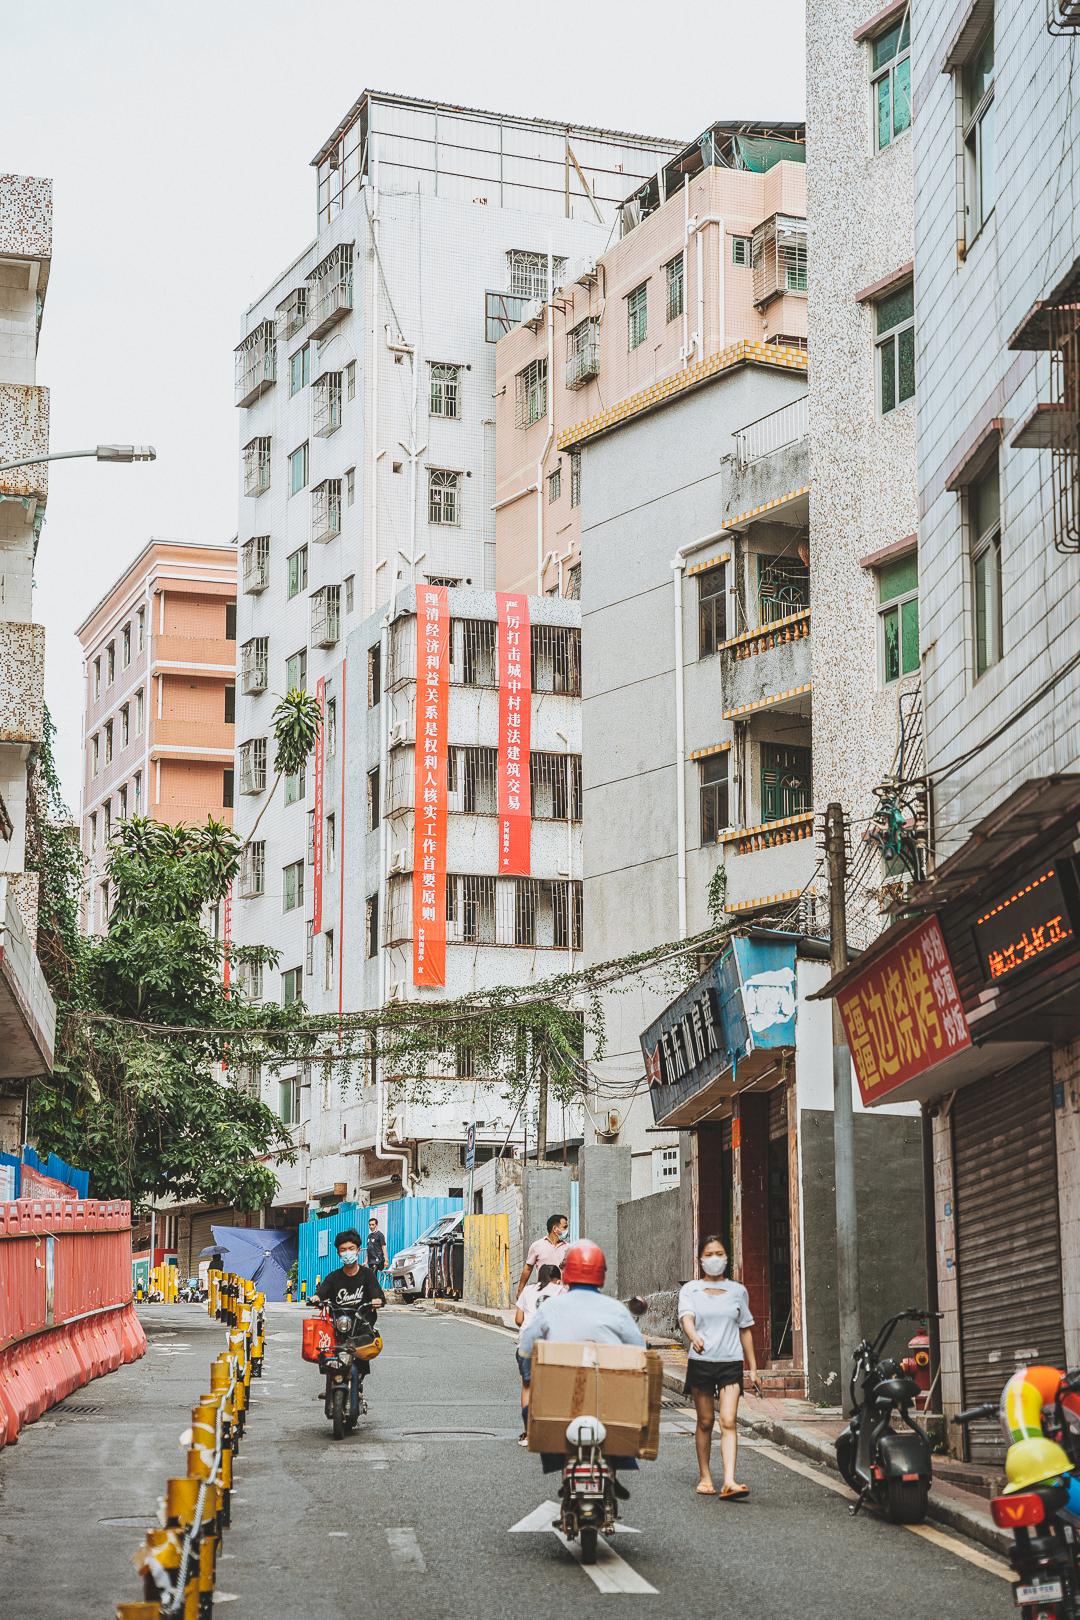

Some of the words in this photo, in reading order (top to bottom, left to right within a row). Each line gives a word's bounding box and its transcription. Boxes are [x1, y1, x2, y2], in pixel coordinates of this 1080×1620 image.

[505, 600, 523, 810] 严厉打击城中村违法建筑交易
[422, 592, 440, 922] 理清经济利益关系是权利人核实工作首要原则
[920, 925, 946, 969] 炒粉
[932, 965, 957, 1009] 炒面
[842, 947, 943, 1091] 疆边烧烤
[943, 1003, 968, 1047] 炒饭
